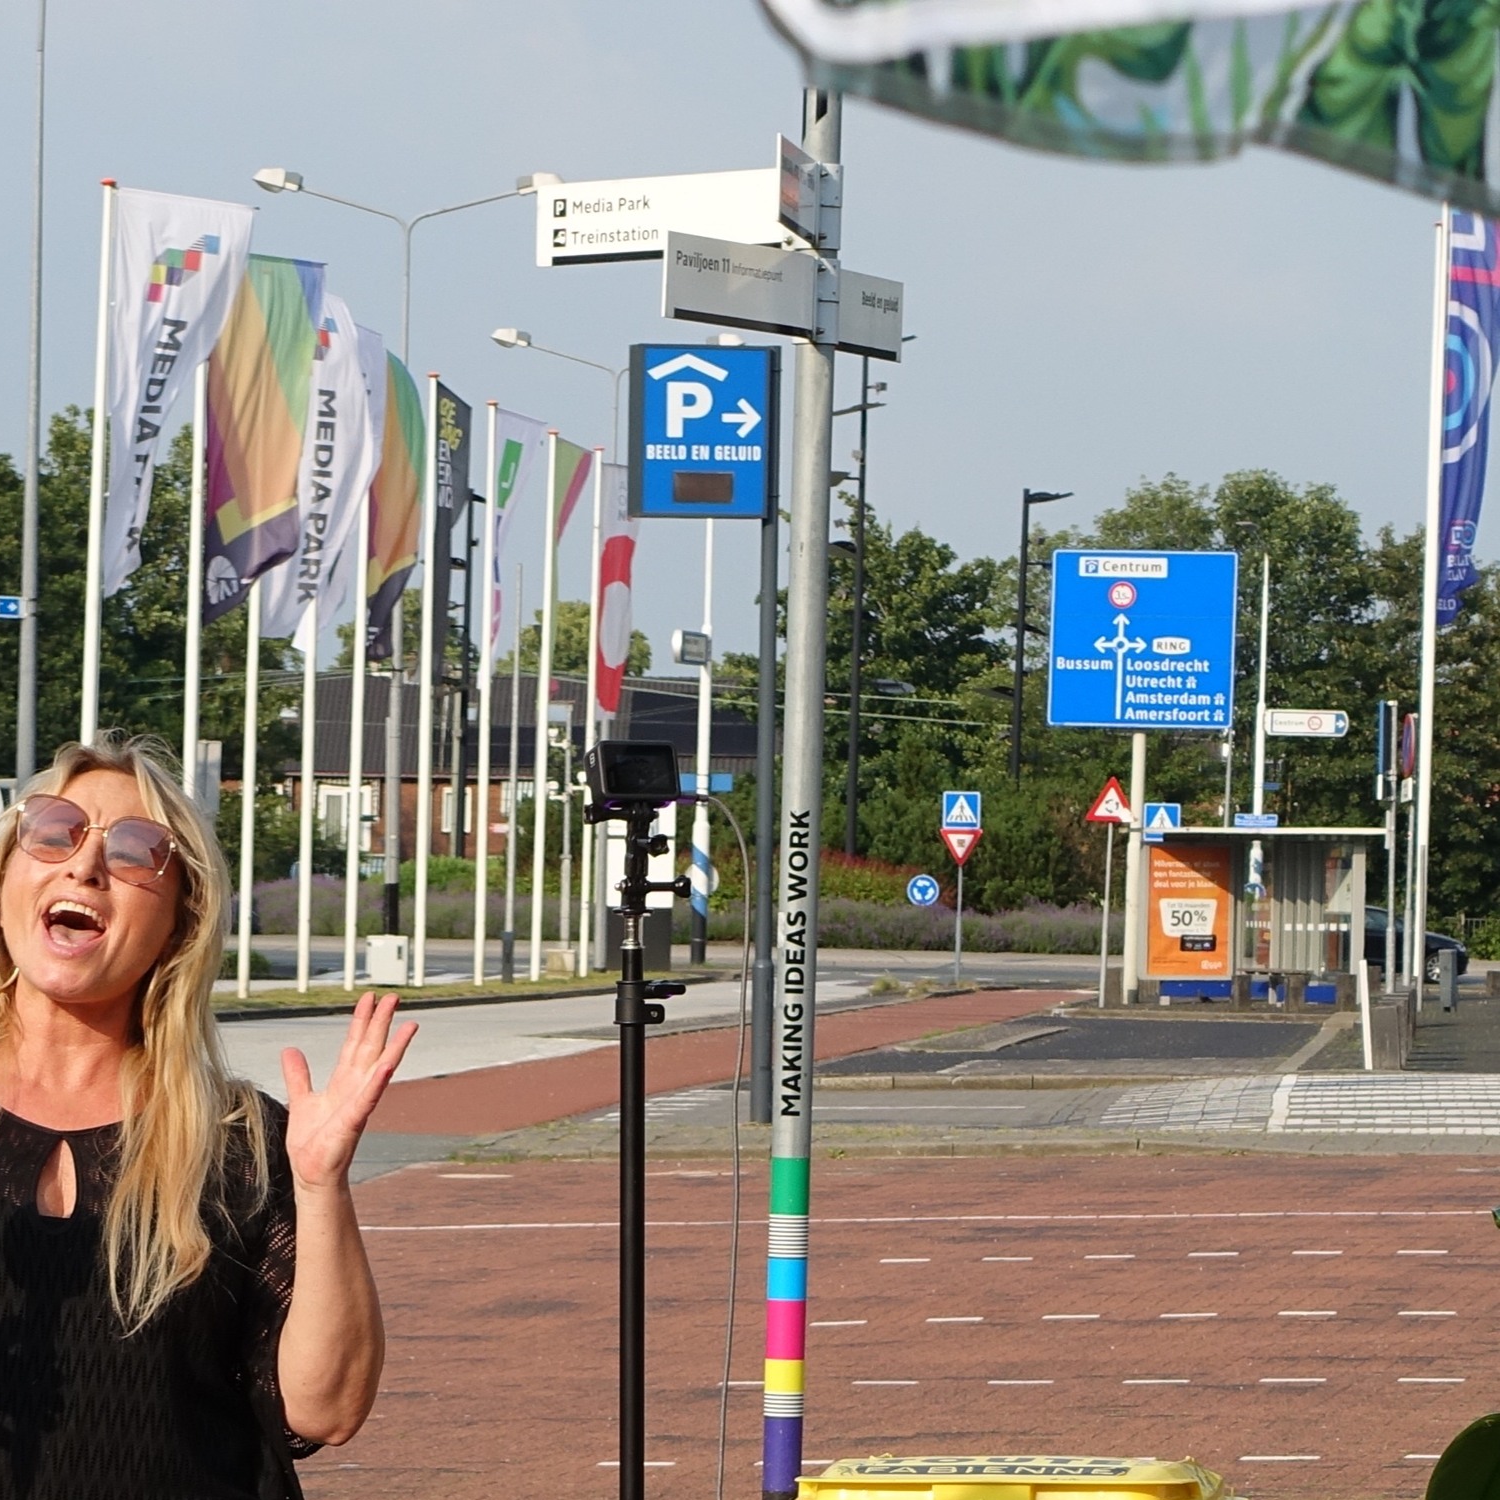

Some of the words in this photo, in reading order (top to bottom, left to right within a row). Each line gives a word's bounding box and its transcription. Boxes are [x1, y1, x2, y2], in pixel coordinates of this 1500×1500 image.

[572, 198, 613, 214] Media
[618, 194, 650, 212] Park
[571, 226, 659, 245] Treinstation
[676, 250, 720, 273] Paviljoen
[722, 258, 731, 274] 11
[136, 317, 188, 445] MEDIA
[311, 388, 337, 504] MEDIA
[646, 444, 687, 461] BEELD
[691, 444, 710, 461] EN
[714, 444, 762, 462] GELUID
[297, 513, 328, 604] PARK
[1102, 560, 1163, 573] Centrum
[1156, 640, 1187, 651] RING
[1056, 656, 1113, 671] Bussum
[1126, 658, 1210, 673] Loosdrecht
[1125, 675, 1182, 689] Utrecht
[1125, 691, 1211, 706] Amsterdam
[1124, 708, 1210, 722] Amersfoort
[788, 809, 811, 902] WORK
[1170, 909, 1208, 927] 50%
[785, 910, 807, 995] IDEAS
[781, 1002, 804, 1117] MAKING
[863, 1465, 1110, 1476] FABIENNE
